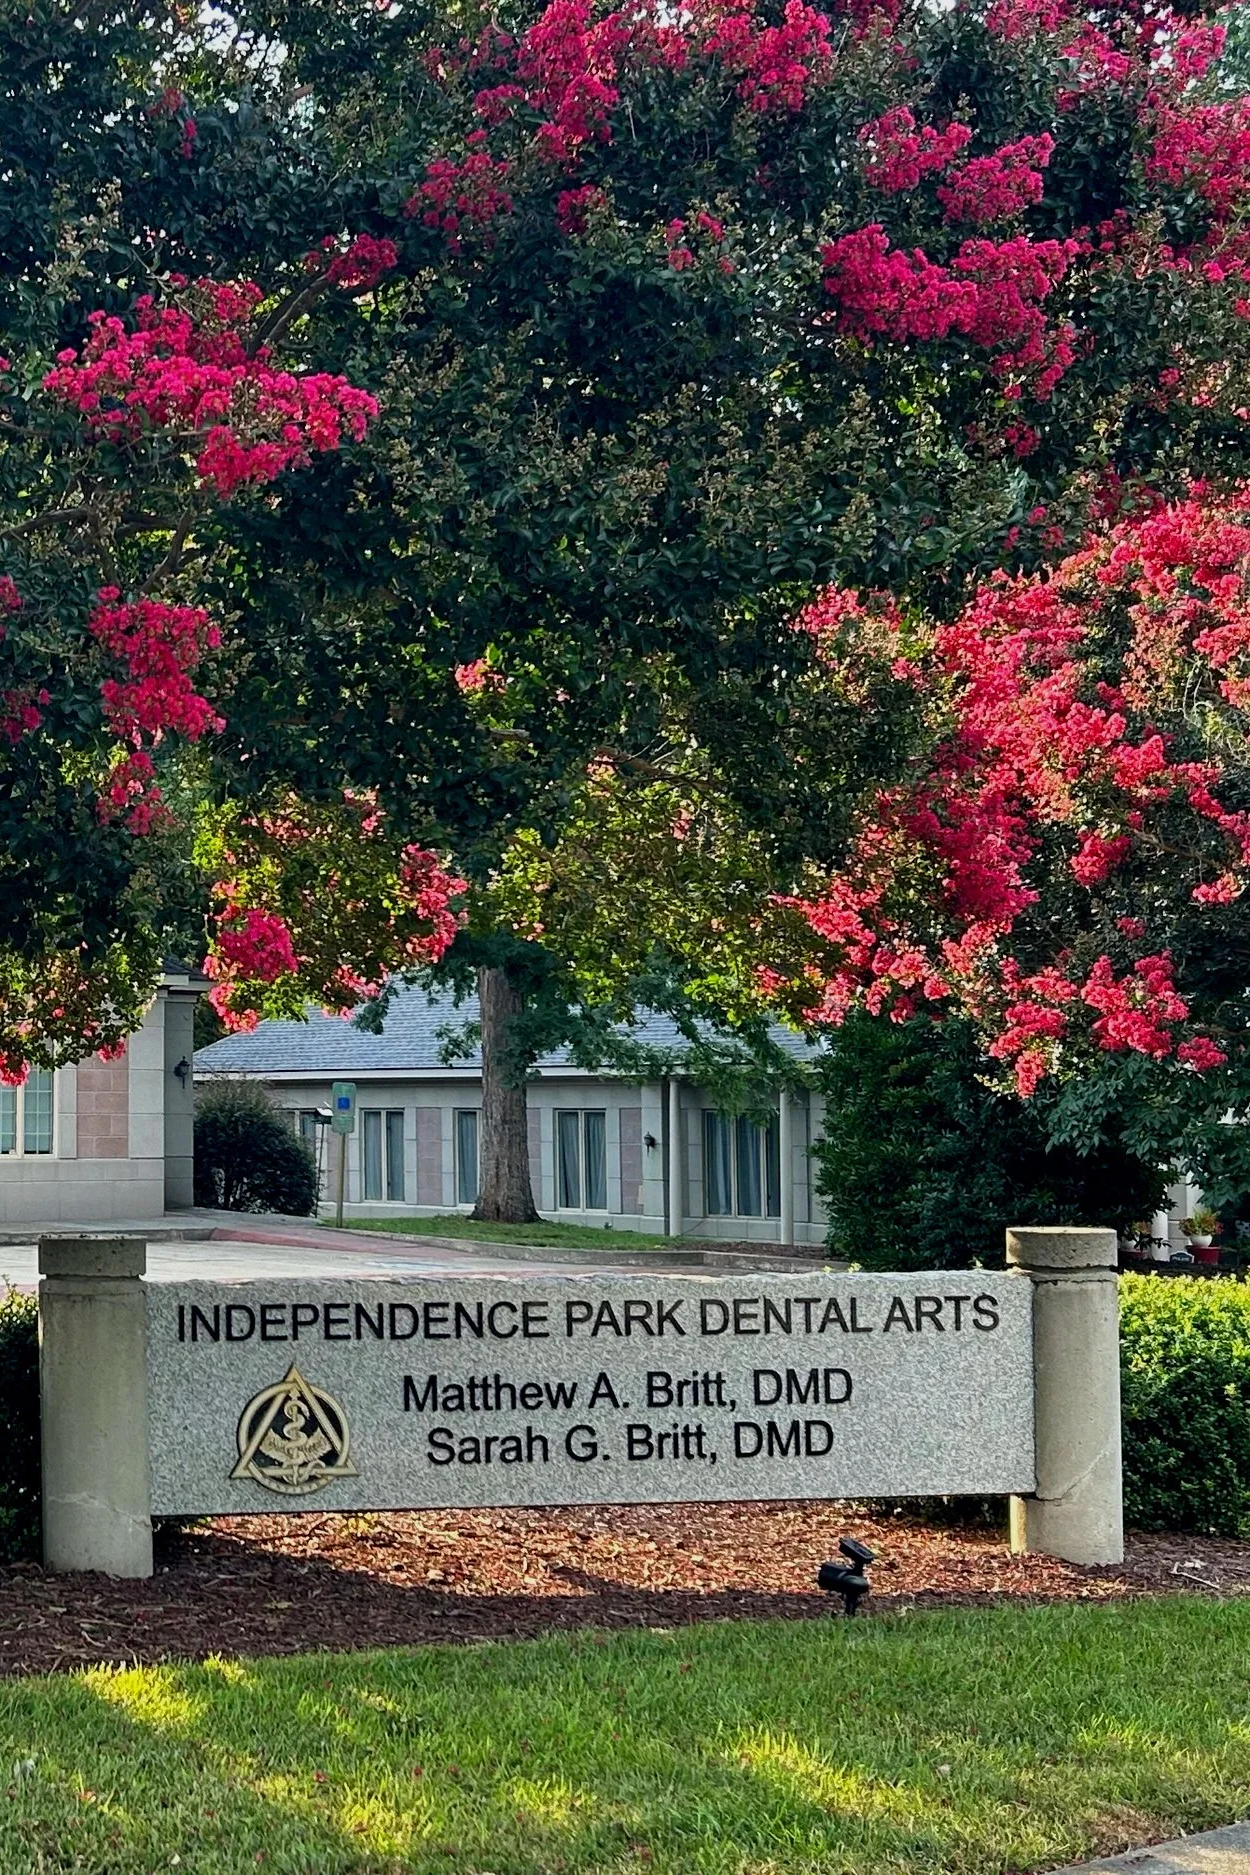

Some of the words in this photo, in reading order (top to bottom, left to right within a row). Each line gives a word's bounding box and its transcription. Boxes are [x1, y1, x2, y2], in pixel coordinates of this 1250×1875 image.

[177, 1301, 550, 1343] INDEPENDENCE
[565, 1299, 687, 1338] PARK
[699, 1295, 874, 1336] DENTAL
[882, 1293, 1000, 1333] ARTS
[402, 1373, 579, 1413] Matthew
[587, 1371, 630, 1410] A.
[646, 1371, 737, 1413] Britt,
[752, 1368, 853, 1406] DMD
[426, 1425, 550, 1467] Sarah
[564, 1424, 611, 1464] G.
[626, 1422, 717, 1466] Britt,
[733, 1419, 834, 1459] DMD
